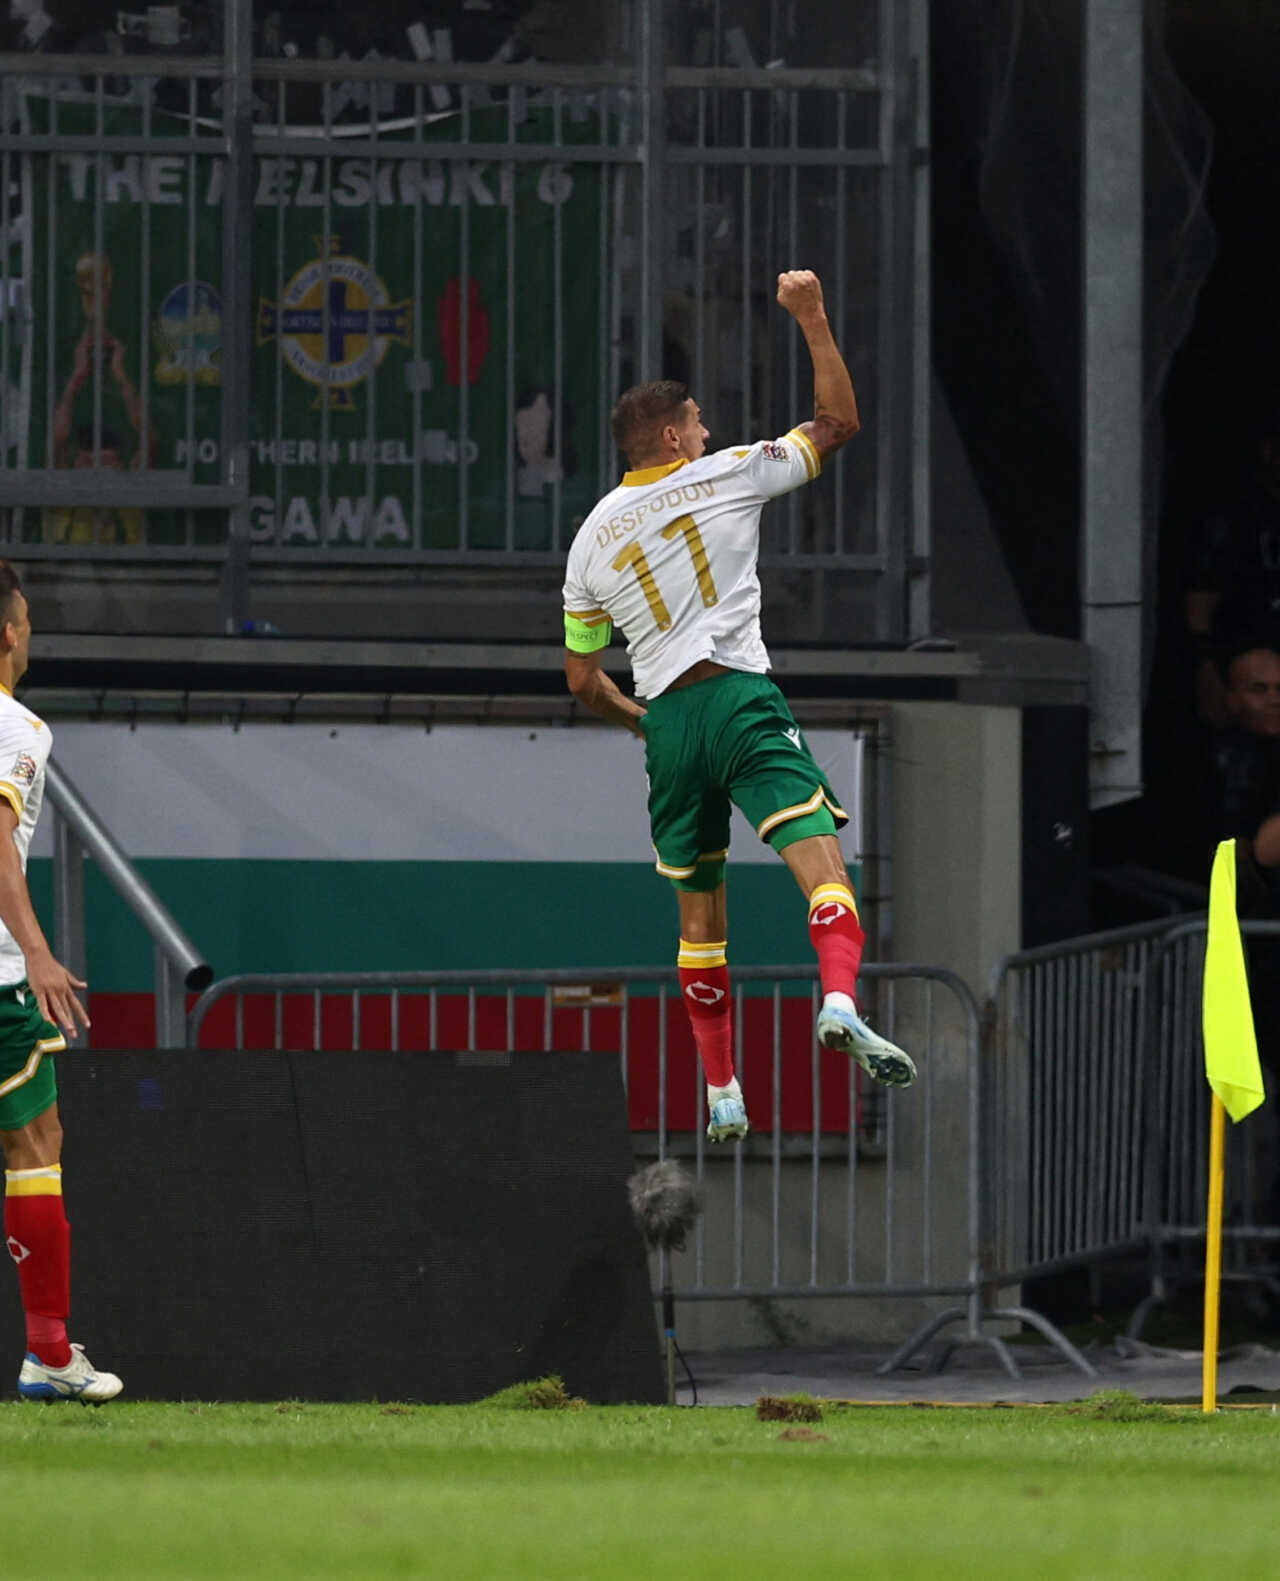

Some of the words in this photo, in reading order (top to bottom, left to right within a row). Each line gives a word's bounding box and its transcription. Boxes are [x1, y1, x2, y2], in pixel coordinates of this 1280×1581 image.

[64, 153, 184, 205] THE
[534, 160, 576, 206] 6
[349, 440, 482, 465] IRELND
[249, 494, 410, 542] GAWA
[595, 480, 717, 550] DESPODOV
[612, 513, 719, 632] 11
